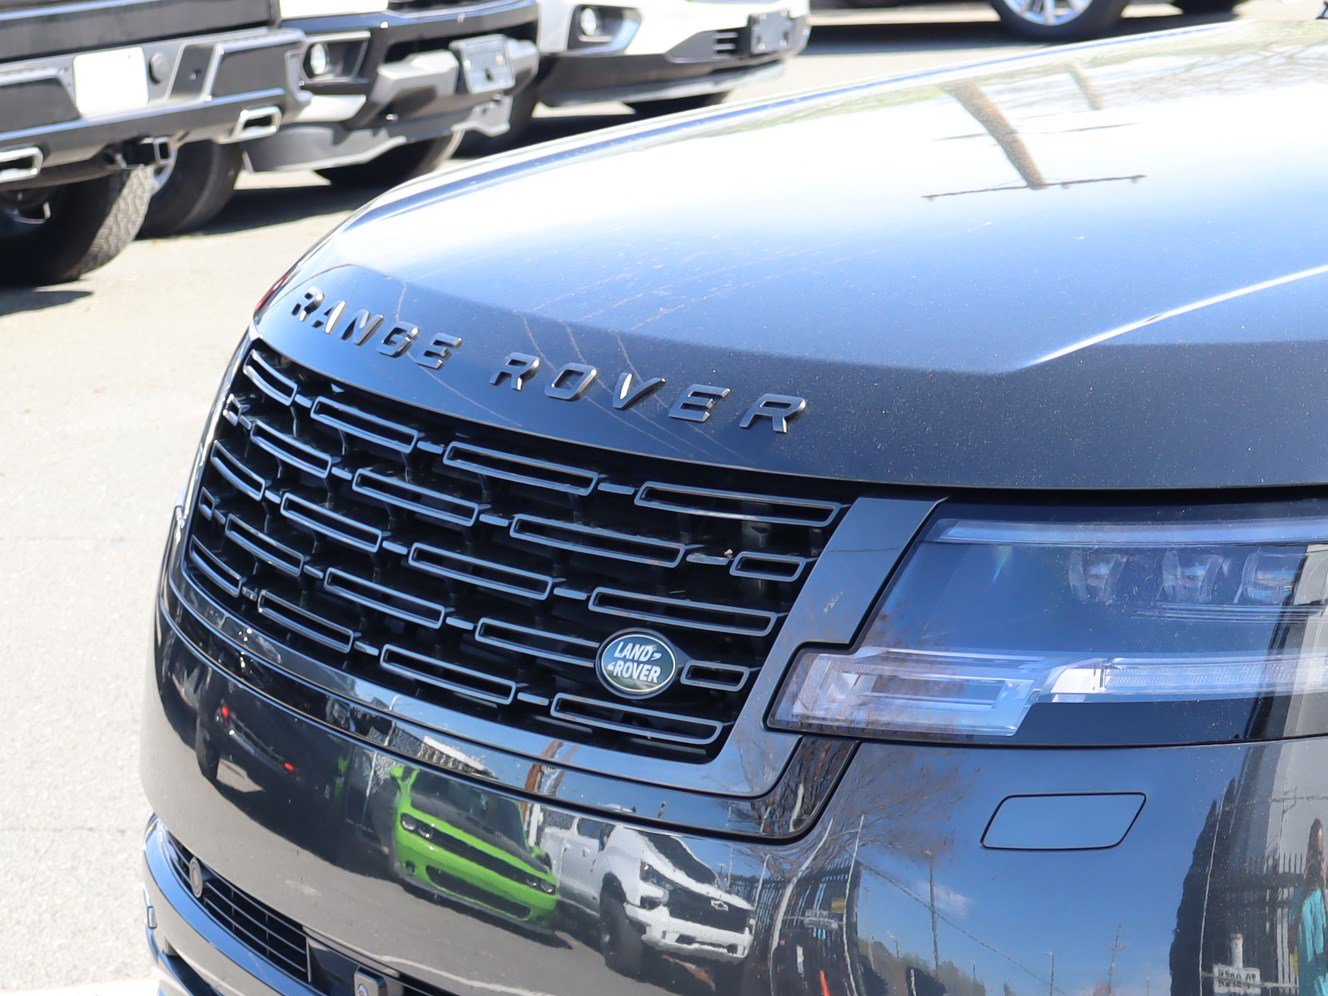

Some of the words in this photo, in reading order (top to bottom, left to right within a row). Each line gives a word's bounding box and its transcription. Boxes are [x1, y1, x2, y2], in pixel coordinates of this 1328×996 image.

[292, 286, 463, 369] RANGE
[489, 351, 807, 434] ROVER
[614, 641, 654, 662] LAND
[613, 660, 661, 684] ROVER
